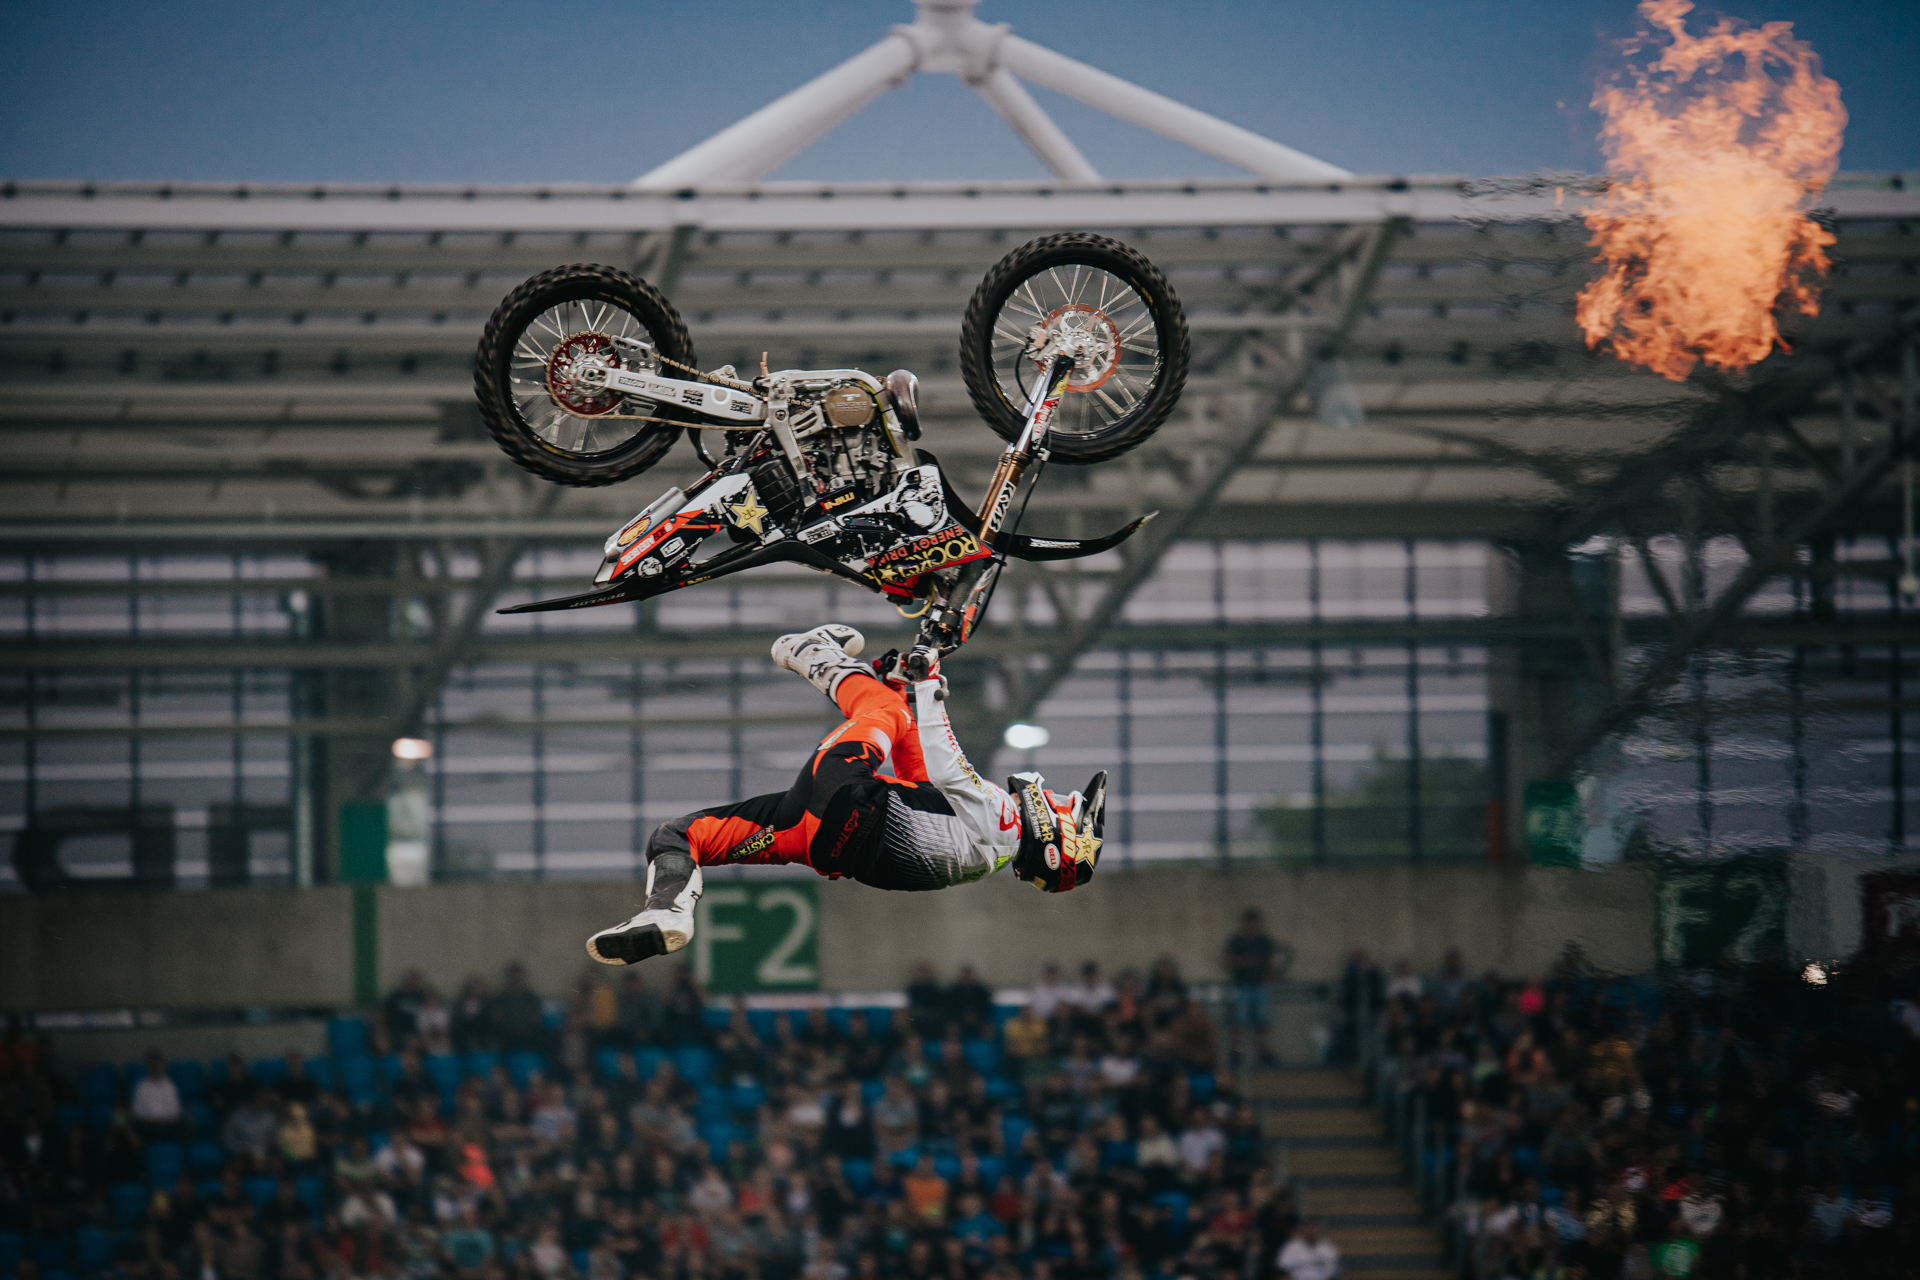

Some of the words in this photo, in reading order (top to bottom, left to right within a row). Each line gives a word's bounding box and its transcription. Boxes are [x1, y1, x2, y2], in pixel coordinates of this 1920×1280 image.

[912, 524, 963, 553] ENERGY
[866, 547, 908, 568] DRINK
[569, 591, 625, 608] DUNLOP
[1056, 811, 1077, 876] 100%
[1047, 847, 1058, 867] BELL
[695, 888, 814, 983] F2
